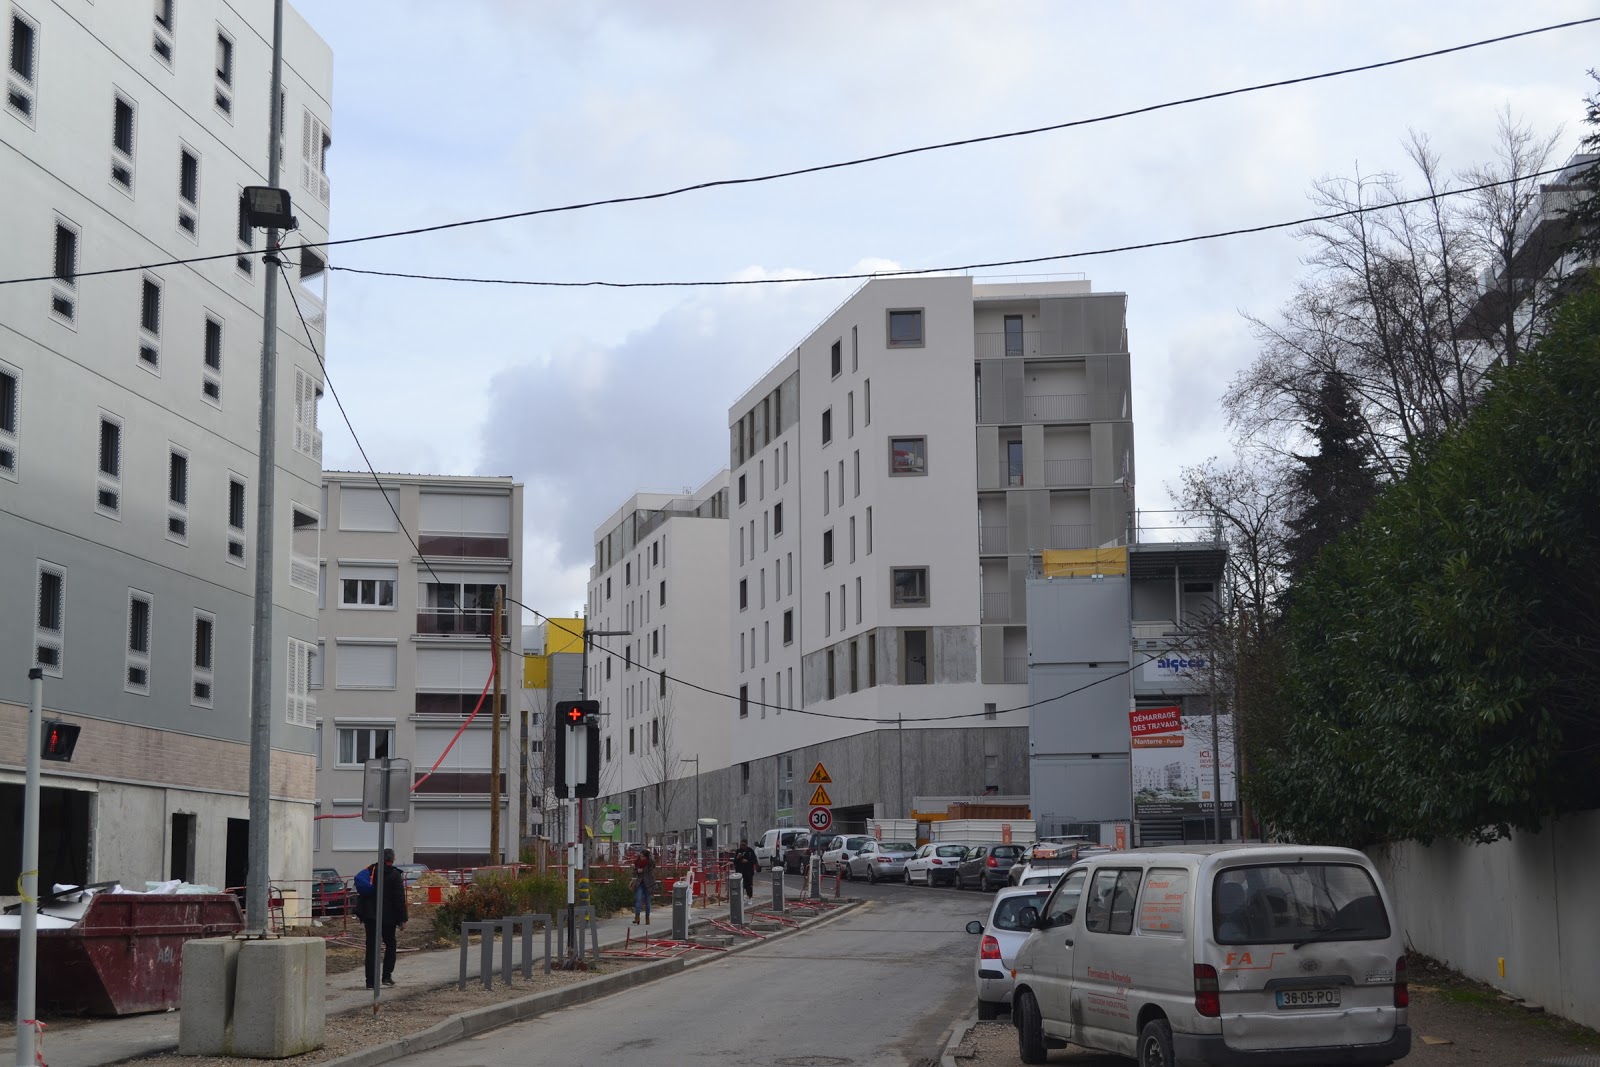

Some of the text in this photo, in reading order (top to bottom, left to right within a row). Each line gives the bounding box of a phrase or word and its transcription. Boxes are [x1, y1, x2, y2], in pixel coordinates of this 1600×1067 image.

[1157, 658, 1205, 672] algeco
[1133, 711, 1176, 723] DÉMARRAGE
[1132, 720, 1180, 732] DES TRAVAUX
[813, 813, 827, 824] 30
[1088, 966, 1132, 983] Fernando Almeida
